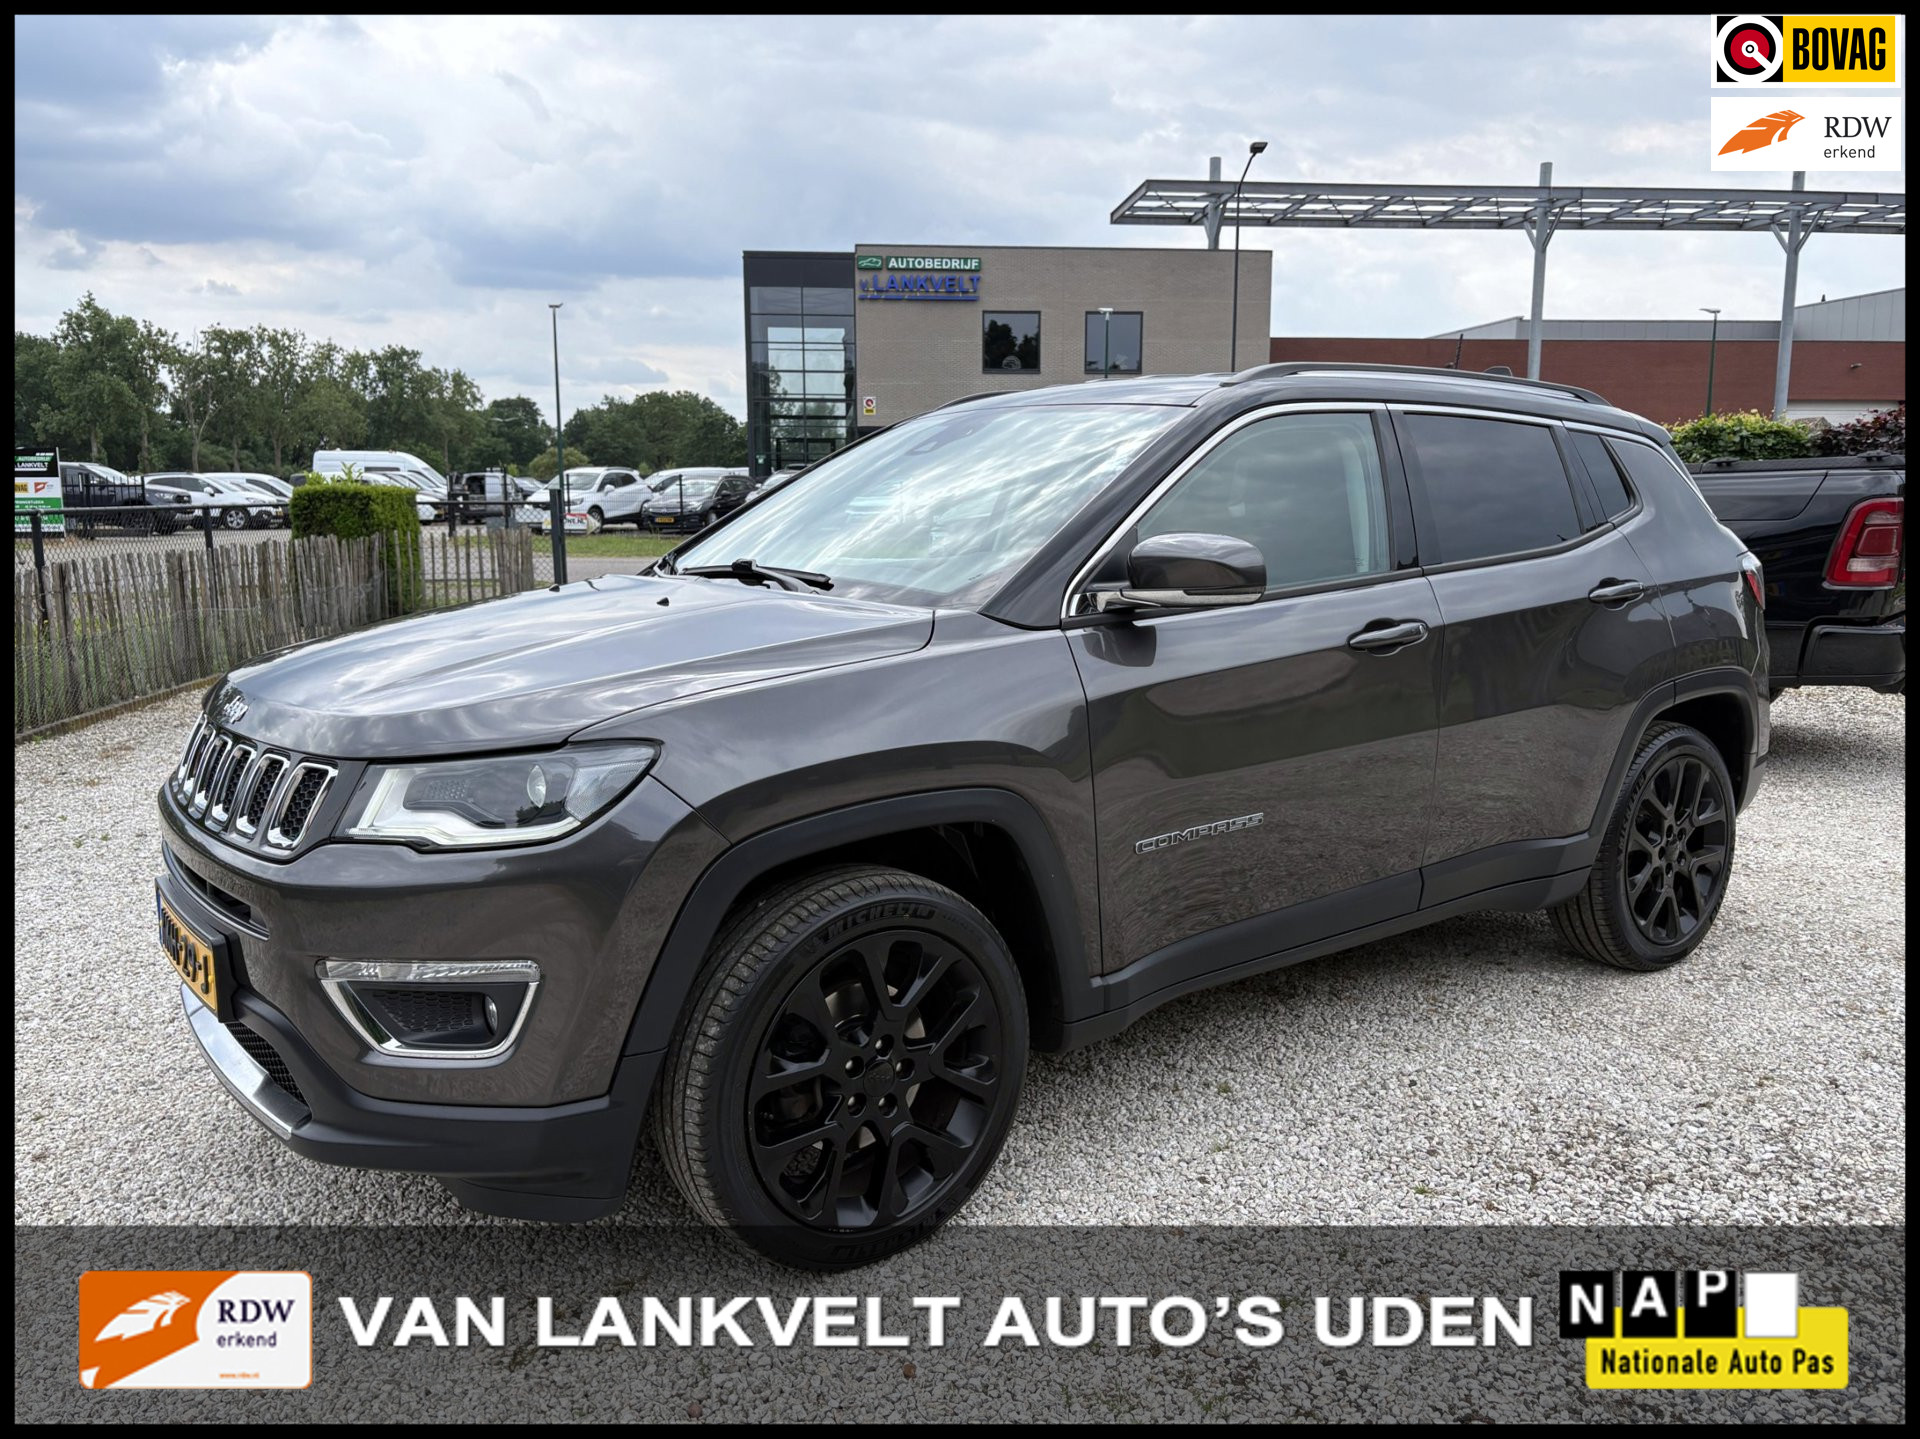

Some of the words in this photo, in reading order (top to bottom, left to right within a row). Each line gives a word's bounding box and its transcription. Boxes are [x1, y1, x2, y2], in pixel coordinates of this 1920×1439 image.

[887, 257, 980, 269] AUTOBEDRIJF
[872, 274, 981, 292] LANKVELT
[1134, 812, 1265, 855] COMPASS
